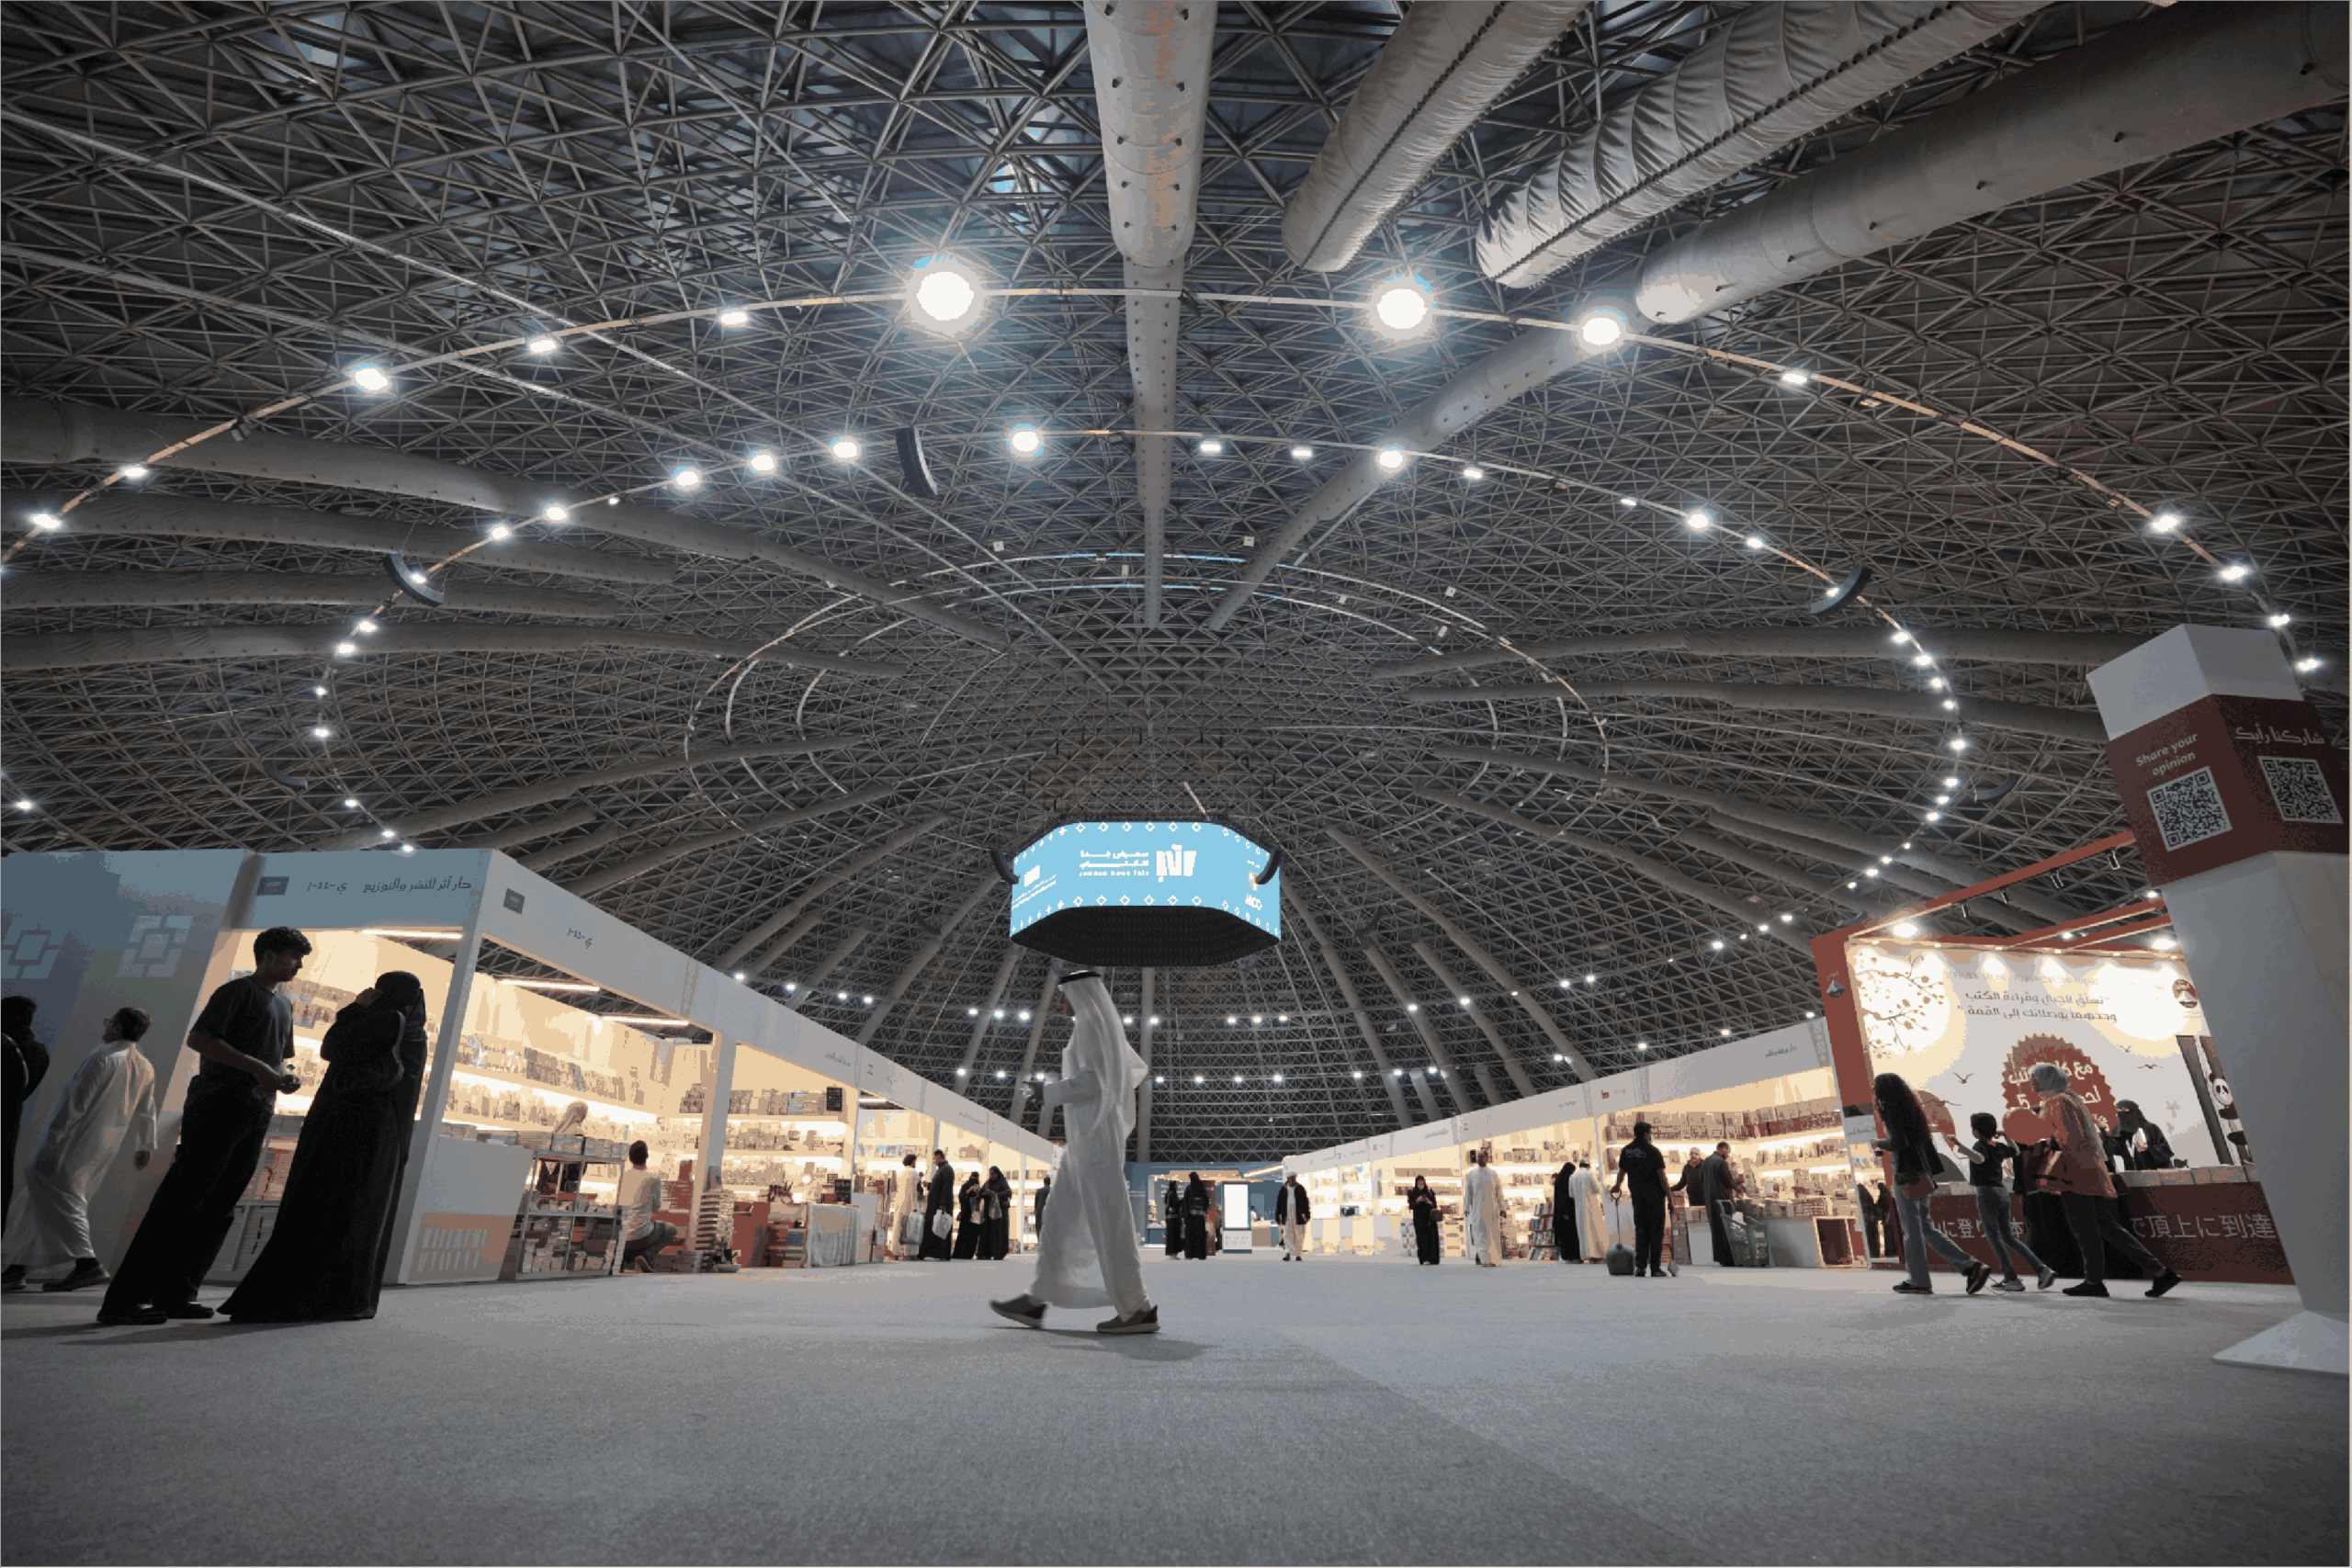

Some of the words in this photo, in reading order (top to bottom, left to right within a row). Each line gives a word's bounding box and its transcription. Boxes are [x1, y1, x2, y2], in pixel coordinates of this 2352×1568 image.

[2234, 722, 2270, 743] رأيك
[2268, 725, 2324, 746] شاركنا
[2136, 745, 2170, 767] Share
[2171, 733, 2199, 756] your
[2152, 751, 2196, 776] opinion
[362, 876, 407, 894] والتوزيع
[407, 876, 436, 892] للنشر
[436, 874, 453, 891] أثر
[451, 874, 472, 891] دار
[1965, 990, 2000, 1002] الكتب
[2003, 990, 2039, 1005] وقراءة
[2003, 1008, 2020, 1020] إلى
[2073, 1060, 2093, 1080] مع
